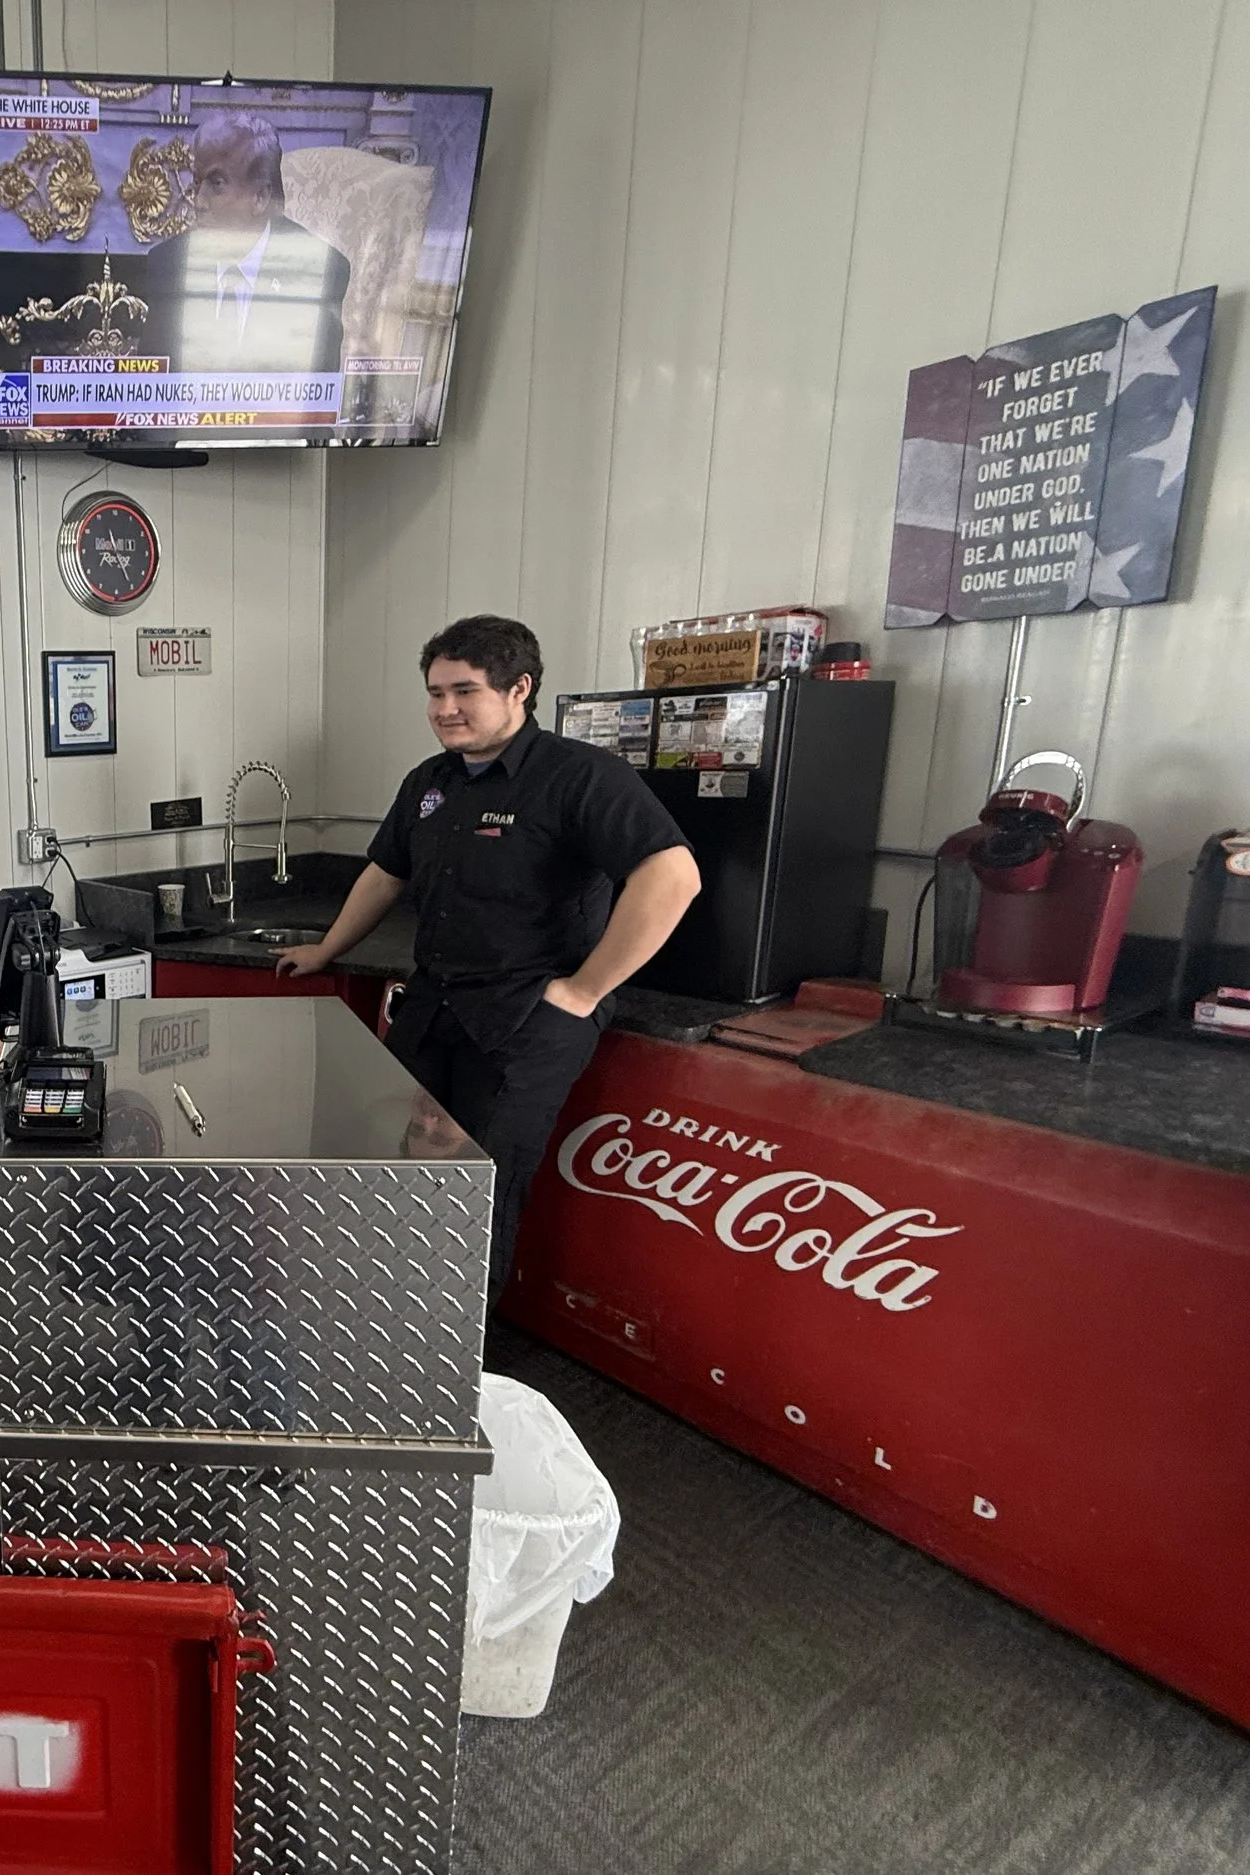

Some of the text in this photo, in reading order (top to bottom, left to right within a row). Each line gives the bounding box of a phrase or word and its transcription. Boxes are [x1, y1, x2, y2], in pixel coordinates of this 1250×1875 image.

[12, 98, 48, 113] WHITE
[51, 100, 90, 115] HOUSE
[40, 118, 63, 130] 12:25
[65, 120, 78, 130] PM
[80, 120, 90, 130] ET
[43, 359, 159, 373] BREAKING NEWS
[1013, 366, 1043, 393] WE
[1049, 351, 1102, 382] EVER
[36, 383, 335, 404] TRUMP: IF IRAN HAD NUKES, THEY WOULD'VE USED IT
[1002, 387, 1078, 423] FORGET
[126, 412, 258, 425] FOX NEWS ALERT
[980, 412, 1098, 455] THAT WE'RE
[977, 443, 1090, 484] ONE NATION
[973, 482, 1035, 511] UNDER
[959, 501, 1095, 540] THEN WE WILL
[962, 530, 1083, 568] BE A NATION
[960, 569, 1007, 594] GONE
[150, 640, 202, 665] MOBIL
[655, 638, 751, 658] Good morning
[71, 714, 88, 722] OIL
[420, 801, 435, 810] OIL
[481, 812, 514, 824] ETHAN
[642, 1107, 782, 1163] DRINK
[556, 1113, 965, 1312] Coca-Cola
